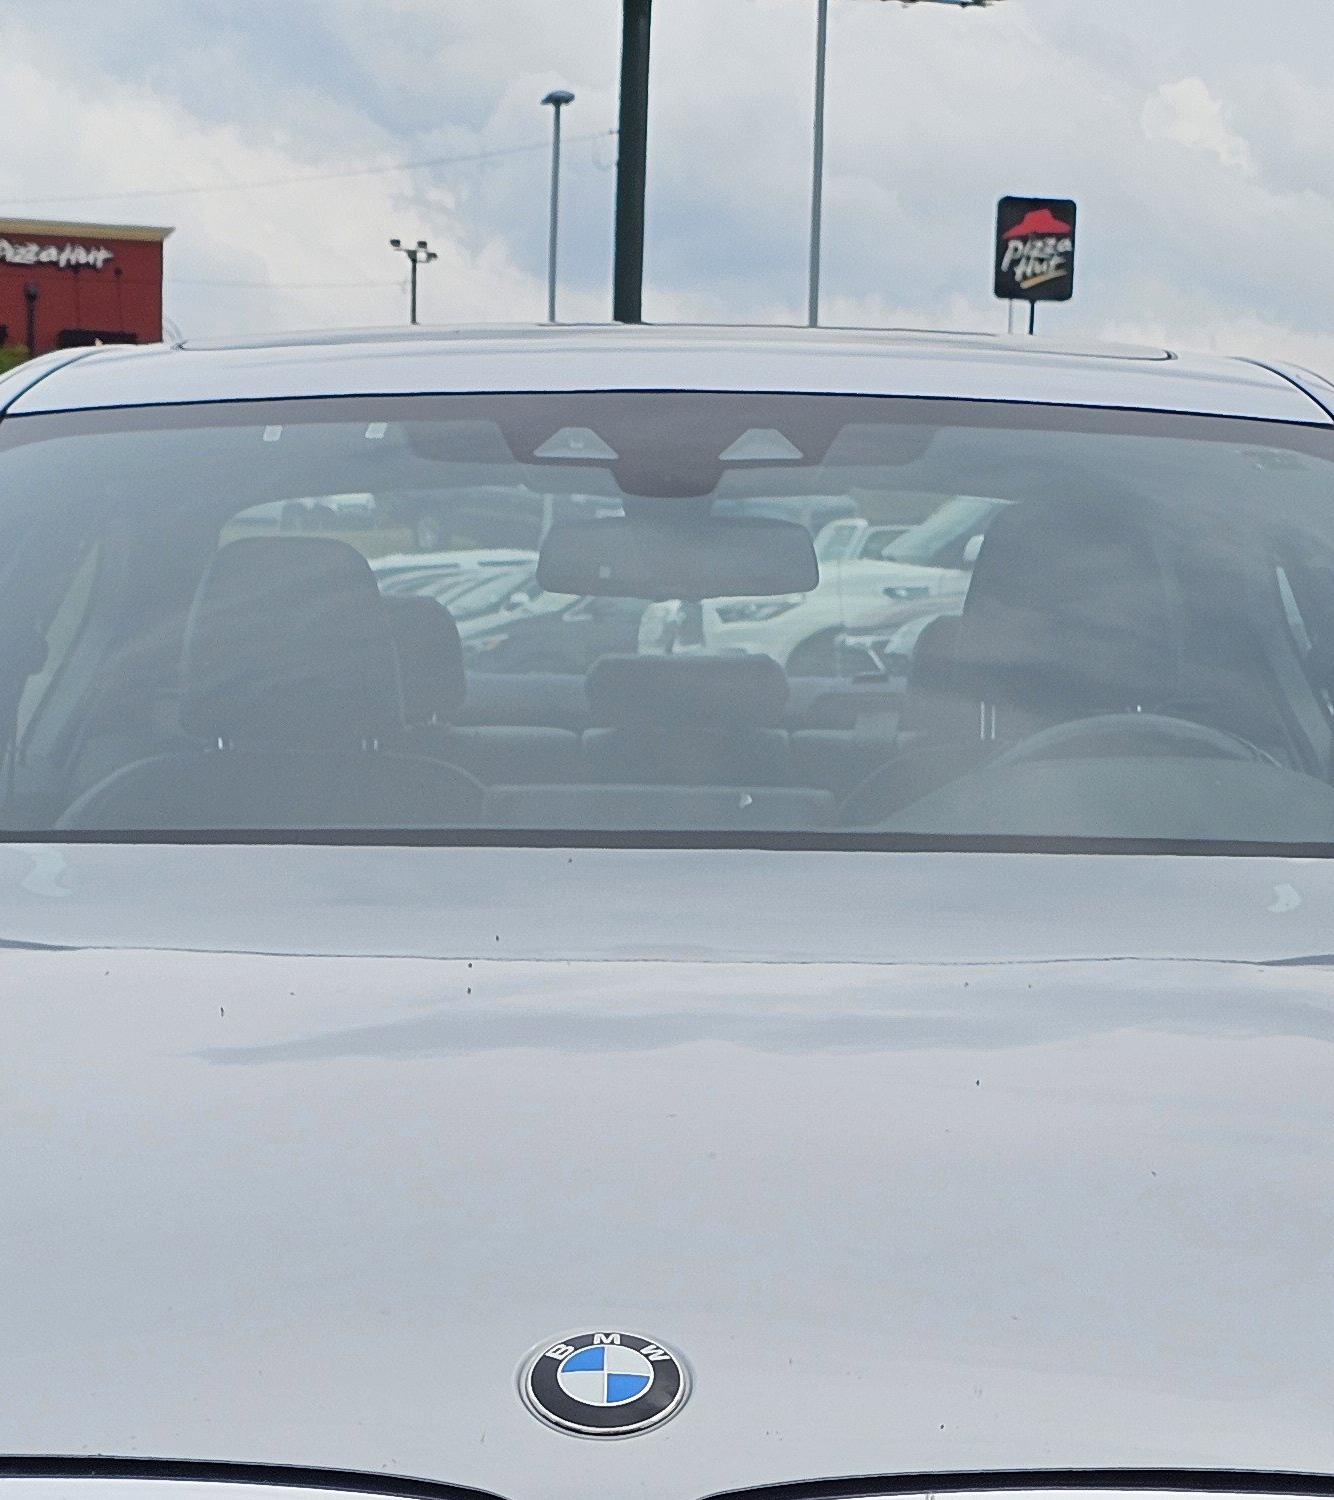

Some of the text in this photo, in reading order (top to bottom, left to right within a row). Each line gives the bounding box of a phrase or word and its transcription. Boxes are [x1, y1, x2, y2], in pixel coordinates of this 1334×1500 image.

[1001, 237, 1073, 273] Pizza
[1014, 254, 1068, 282] Hut
[545, 1333, 671, 1362] BMW
